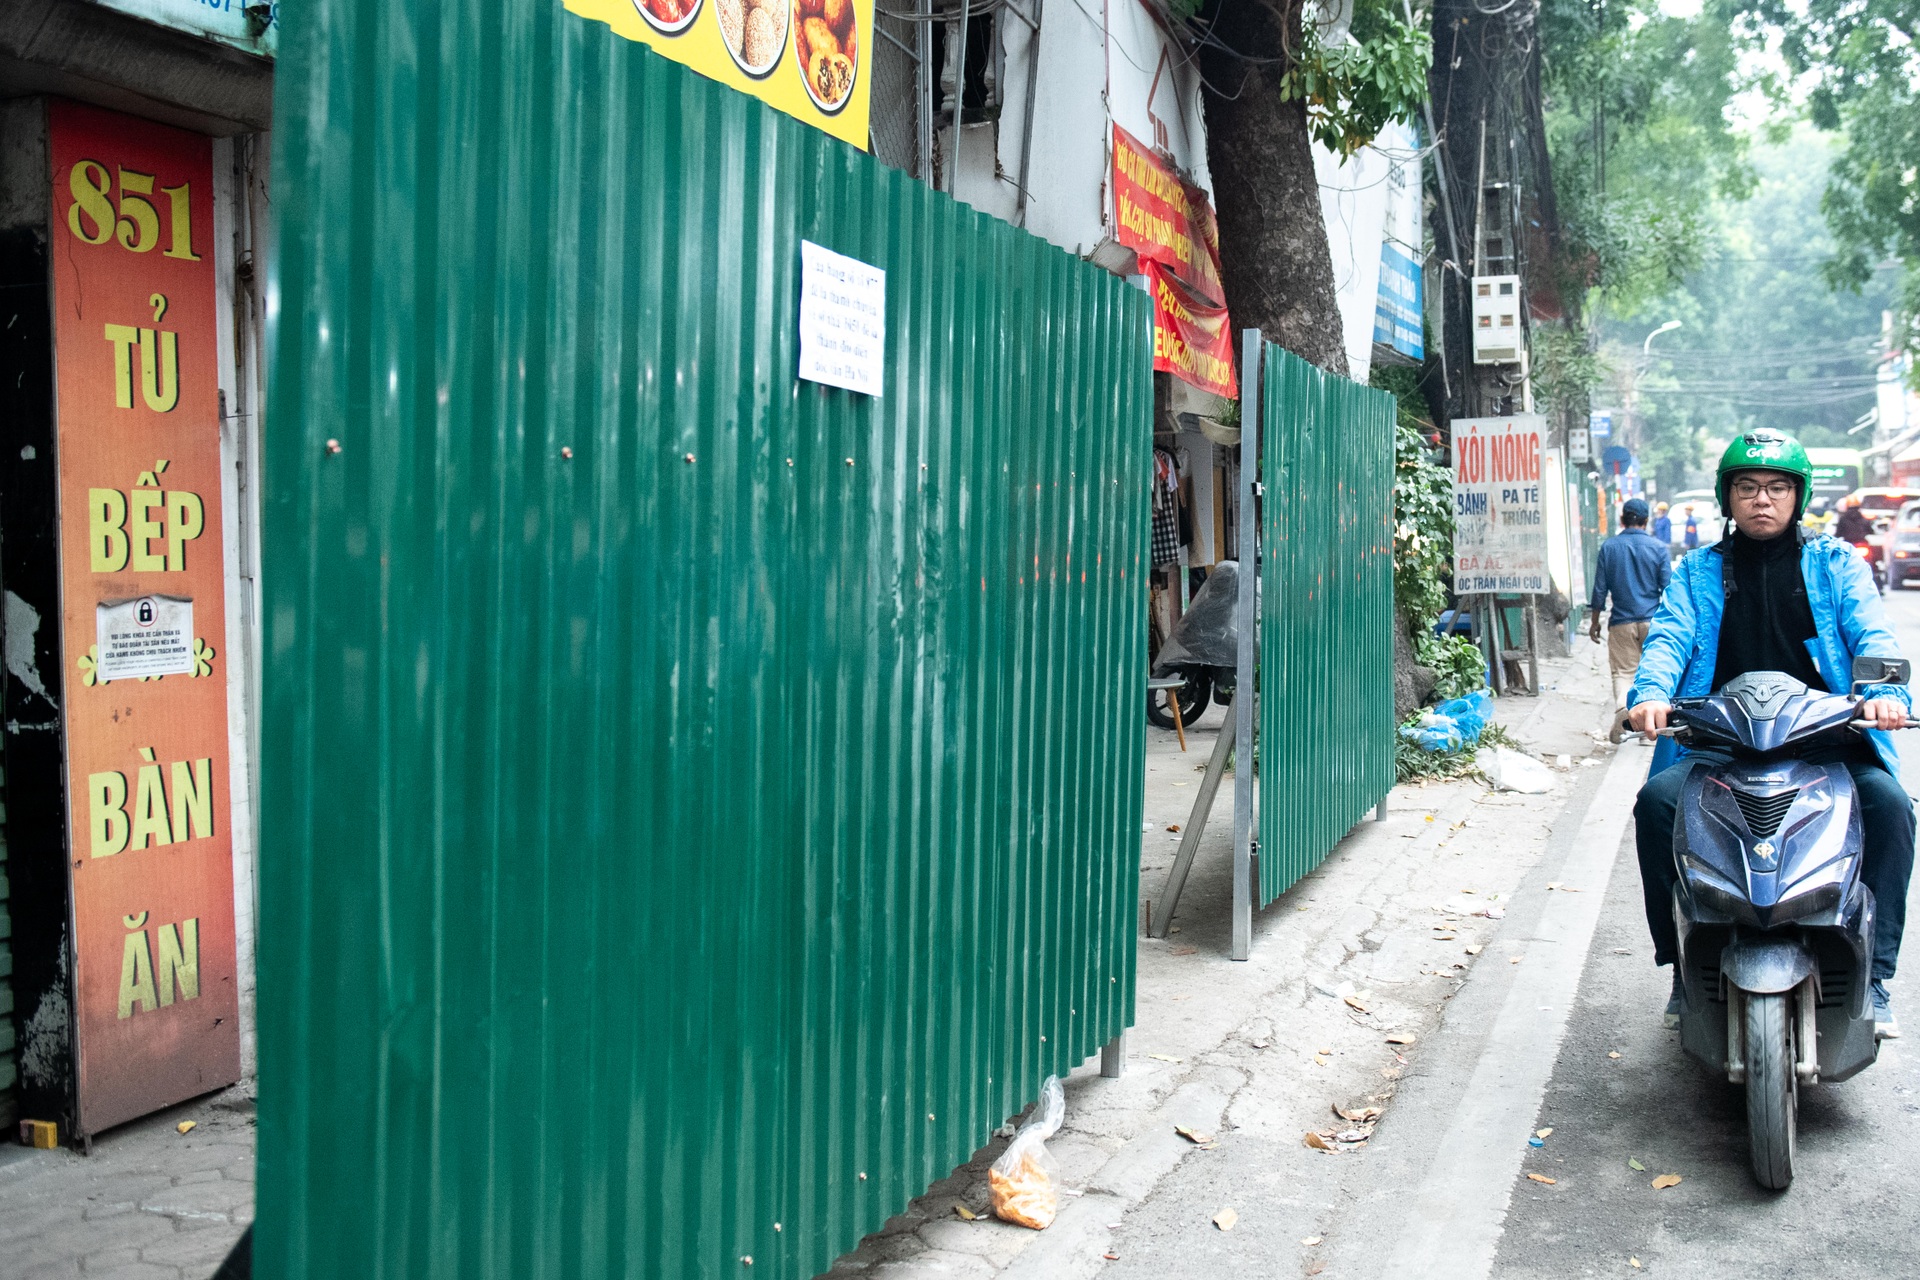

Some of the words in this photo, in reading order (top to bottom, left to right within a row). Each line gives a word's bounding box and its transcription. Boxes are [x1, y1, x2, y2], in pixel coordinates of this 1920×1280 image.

[68, 160, 201, 262] 851
[104, 293, 179, 413] TỦ
[1457, 425, 1486, 484] XÔI
[1491, 423, 1541, 483] NÓNG
[1457, 488, 1487, 516] BÁNH
[1502, 488, 1519, 504] PA
[1523, 484, 1539, 504] TÊ
[1746, 447, 1780, 459] Grab
[88, 460, 204, 574] BẾP
[88, 747, 213, 859] BÀN
[117, 910, 200, 1020] ĂN
